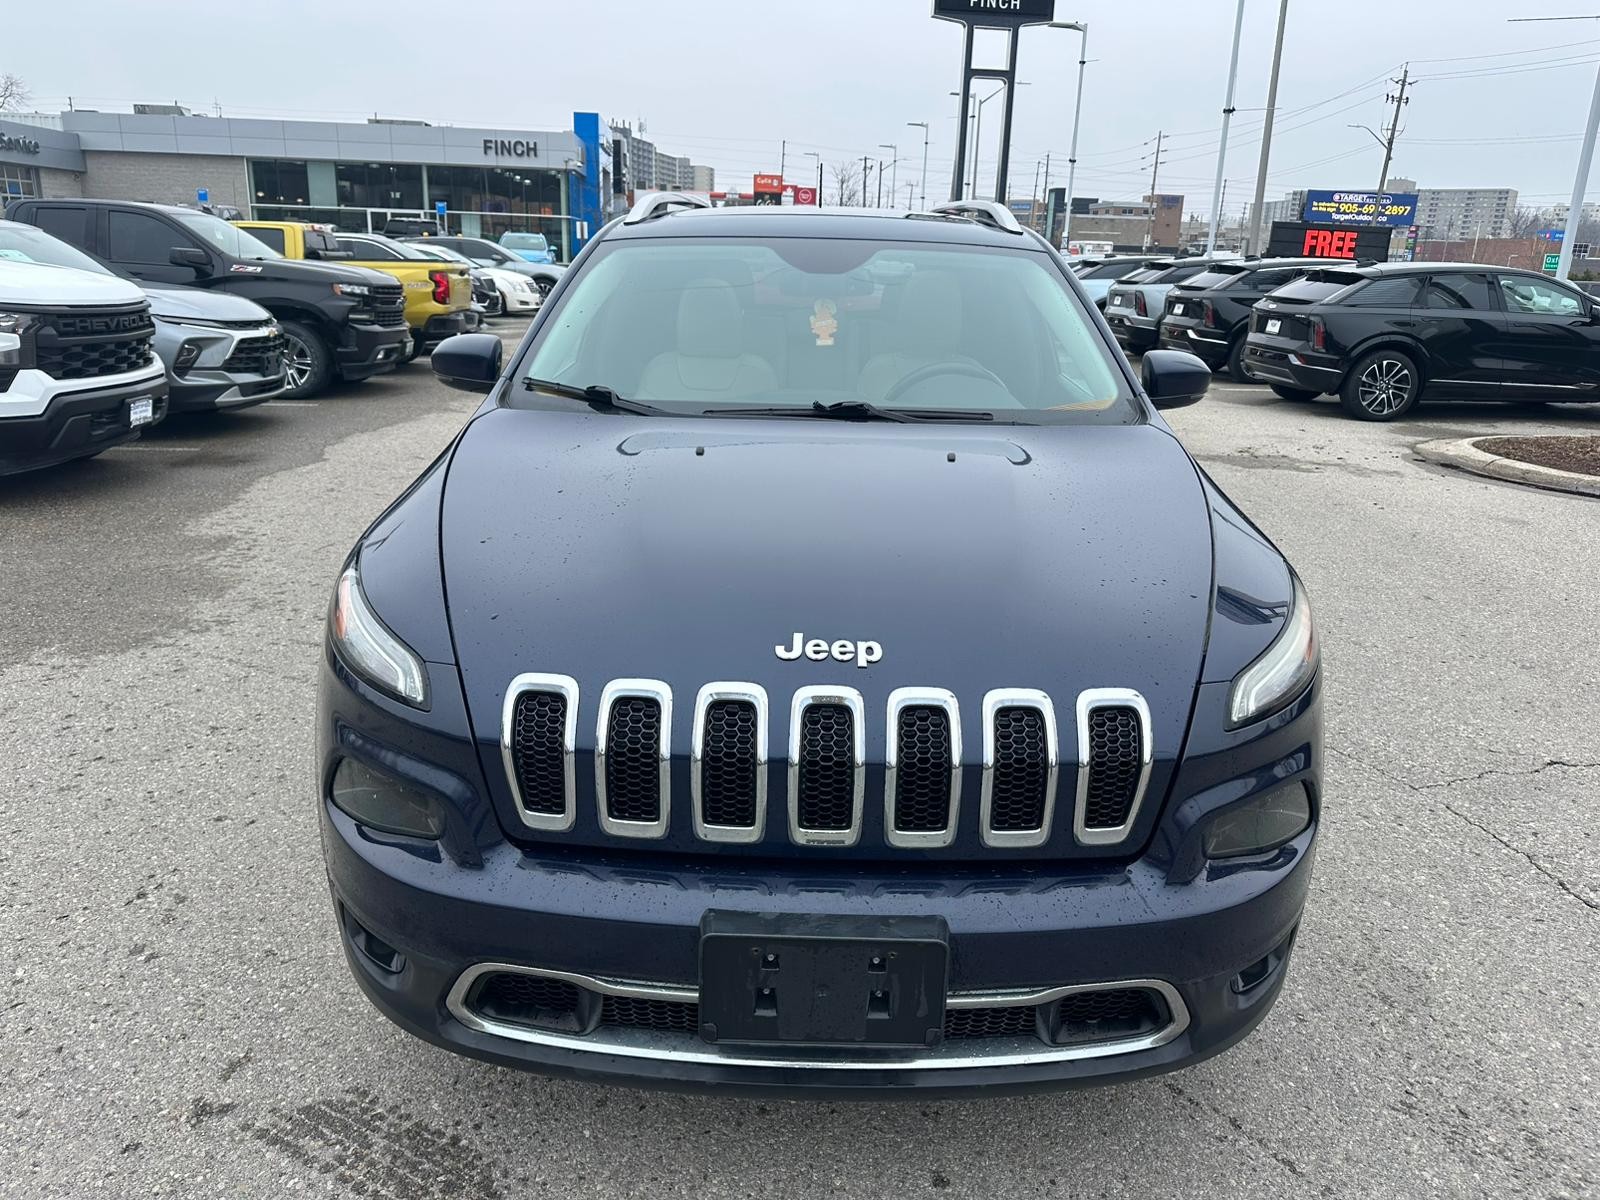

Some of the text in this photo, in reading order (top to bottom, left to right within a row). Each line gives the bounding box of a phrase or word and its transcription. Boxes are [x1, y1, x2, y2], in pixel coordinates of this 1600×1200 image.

[483, 139, 538, 157] FINCH
[1331, 213, 1388, 222] TargetOutdo.ca
[1303, 229, 1358, 258] FREE
[59, 314, 151, 331] CHEVROLE
[774, 631, 883, 669] Jeep
